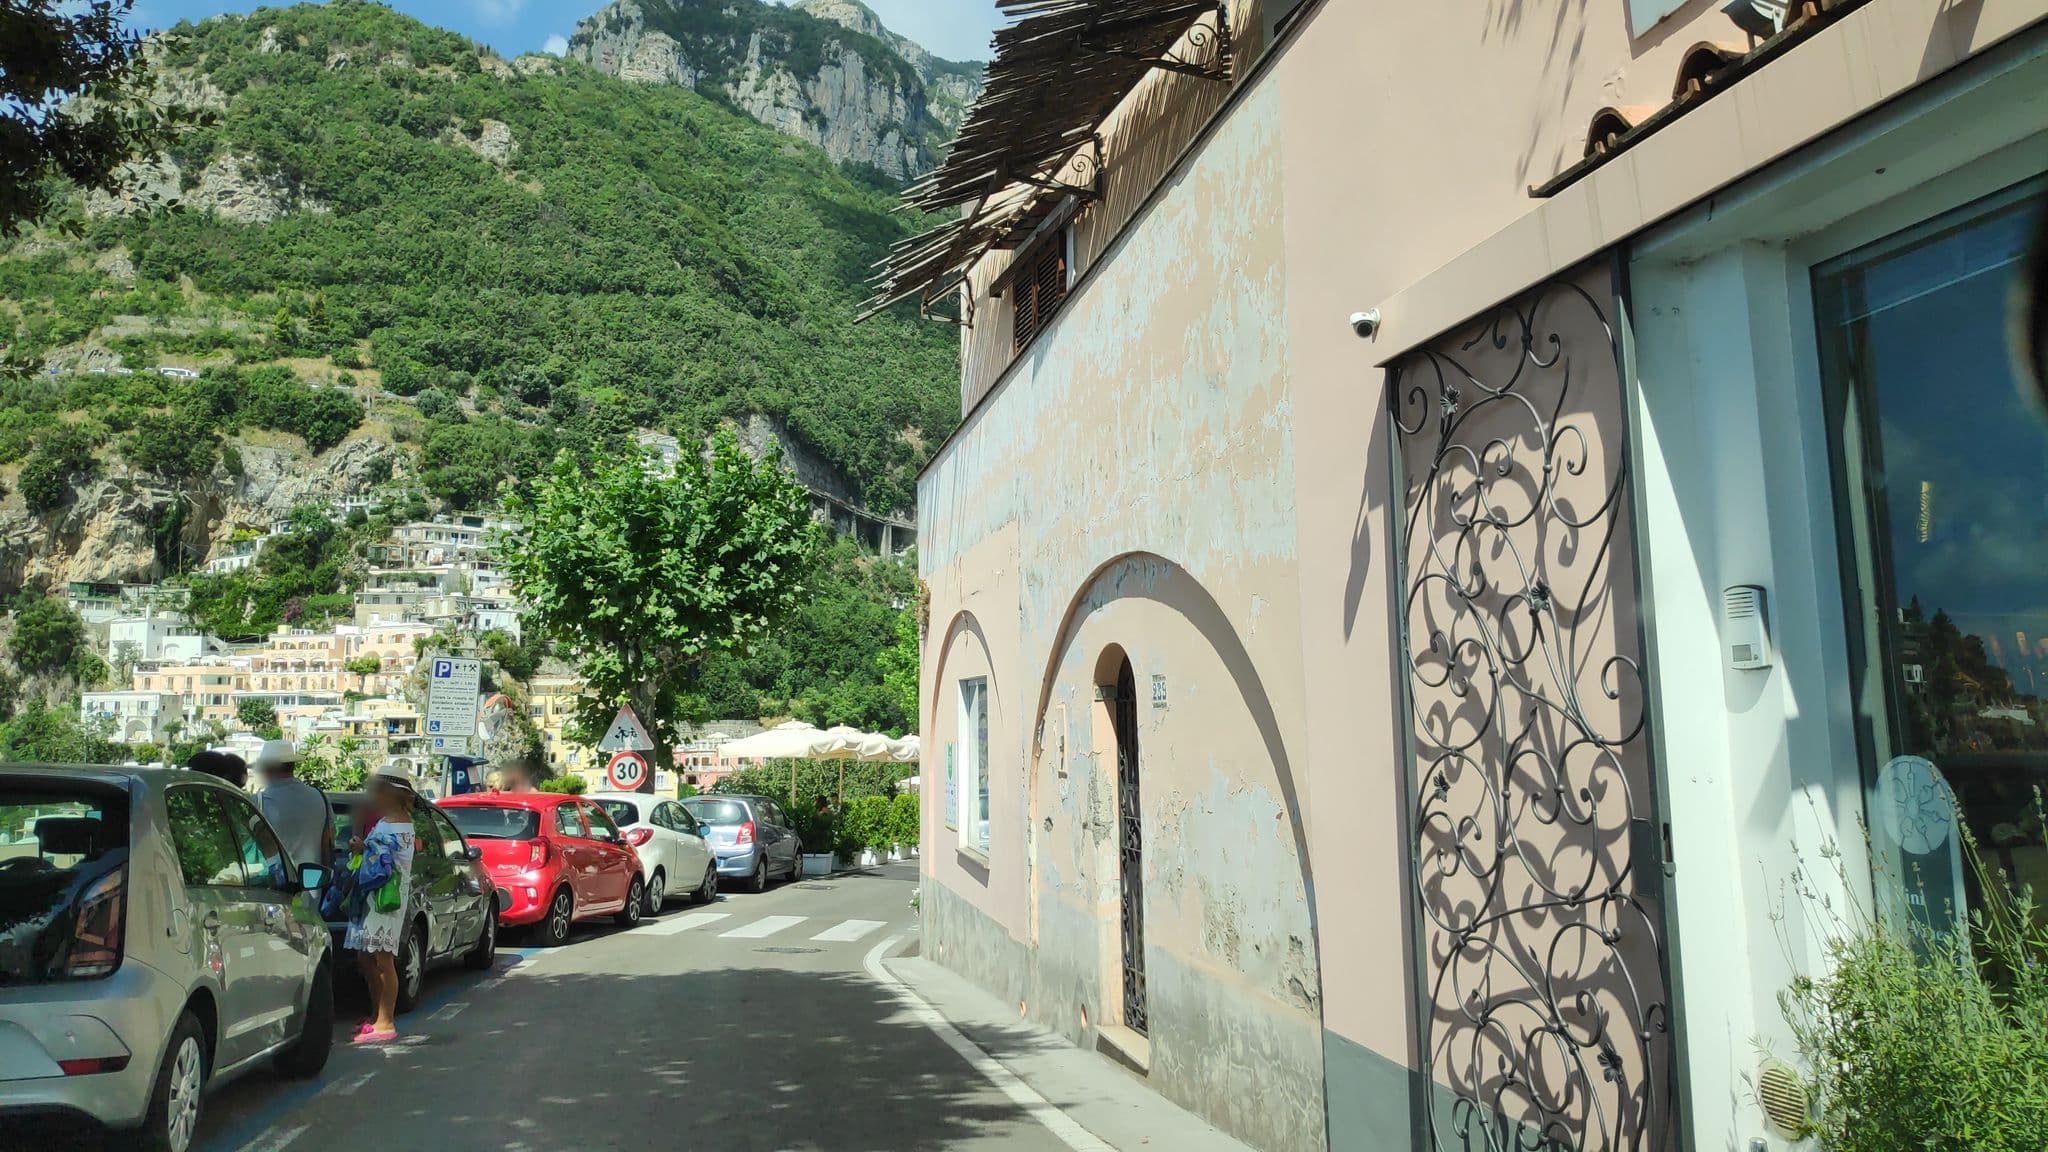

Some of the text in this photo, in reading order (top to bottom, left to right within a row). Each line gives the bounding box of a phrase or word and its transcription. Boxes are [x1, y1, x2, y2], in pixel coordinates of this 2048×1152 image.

[438, 662, 450, 677] P
[456, 770, 465, 785] P
[616, 762, 638, 780] 30
